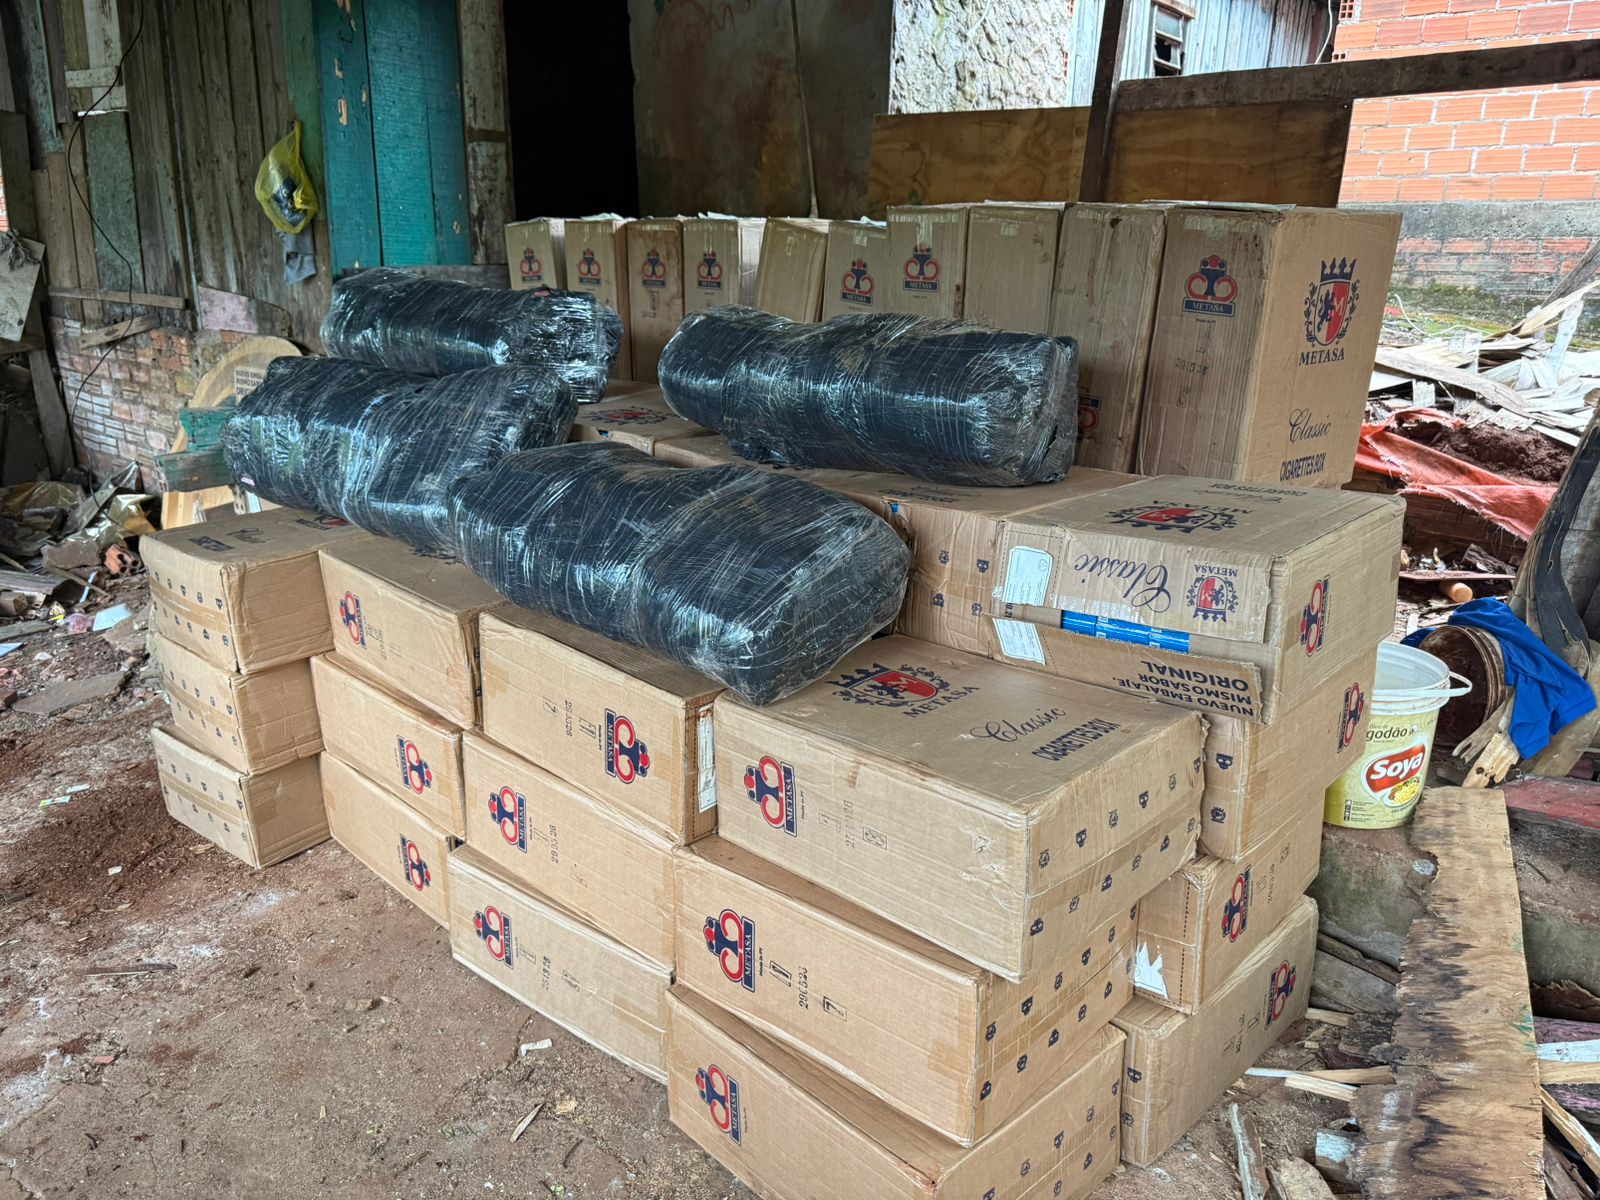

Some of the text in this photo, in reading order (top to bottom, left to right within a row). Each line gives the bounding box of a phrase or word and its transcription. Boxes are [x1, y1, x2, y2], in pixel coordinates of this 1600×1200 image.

[1192, 302, 1224, 313] METASA
[1299, 350, 1345, 367] METASA
[1289, 408, 1332, 444] Classic
[1279, 452, 1328, 482] CIGARETTES BOX
[1075, 553, 1171, 613] Classic
[1194, 564, 1238, 577] METASA
[1141, 660, 1249, 692] ORIGINAL
[902, 685, 980, 718] METASA
[1112, 676, 1254, 717] NUEVO EMBALAJE,
[970, 706, 1066, 742] Classic
[1031, 717, 1121, 761] CIGARETTES BOX
[1366, 727, 1408, 742] godão
[1370, 752, 1423, 780] Soya
[785, 778, 794, 822] METASA
[744, 934, 752, 977] METASA
[730, 1092, 738, 1129] METASA
